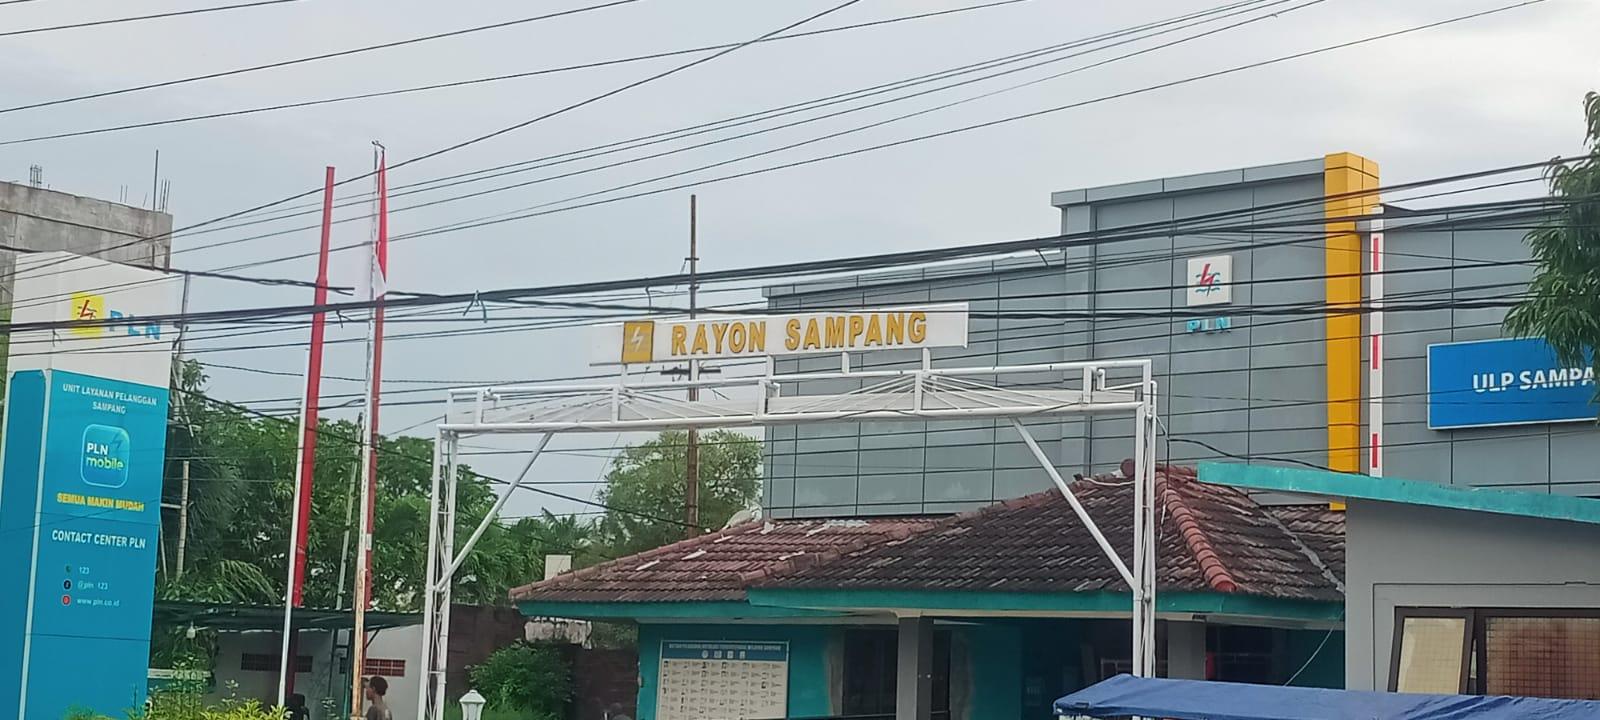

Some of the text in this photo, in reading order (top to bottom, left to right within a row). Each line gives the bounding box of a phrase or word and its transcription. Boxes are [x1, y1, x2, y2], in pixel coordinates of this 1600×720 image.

[109, 310, 161, 341] PLN
[671, 310, 927, 356] RAYON SAMPANG
[1186, 315, 1232, 334] PLN
[1472, 366, 1597, 393] ULP SAMPA
[62, 383, 158, 406] UNIT LAYANAN PELANGGAN
[92, 401, 127, 415] SAMPANG
[86, 442, 109, 456] PLN
[85, 455, 125, 471] mobile
[56, 492, 145, 512] SEMUA MAKIN MUDAH
[51, 529, 146, 549] CONTACT CENTER PLN
[79, 566, 90, 575] 123
